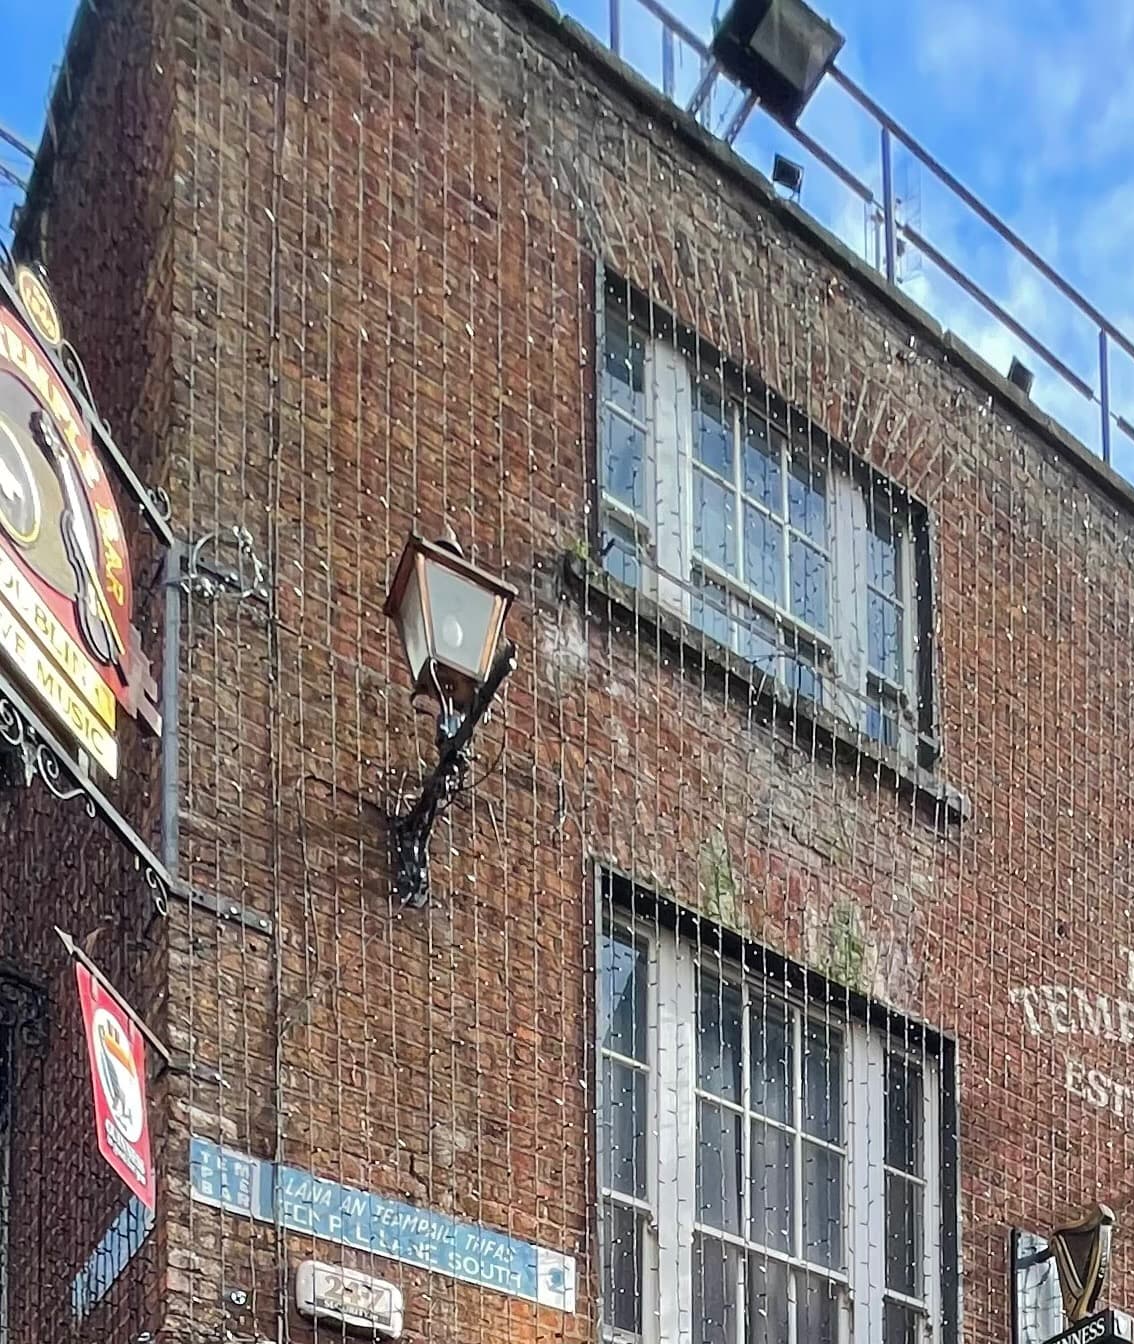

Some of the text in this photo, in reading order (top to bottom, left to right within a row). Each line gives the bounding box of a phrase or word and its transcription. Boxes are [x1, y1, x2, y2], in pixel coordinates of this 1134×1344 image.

[36, 659, 106, 756] MUSIC
[339, 1195, 367, 1217] AN
[447, 1252, 523, 1290] SOUTH
